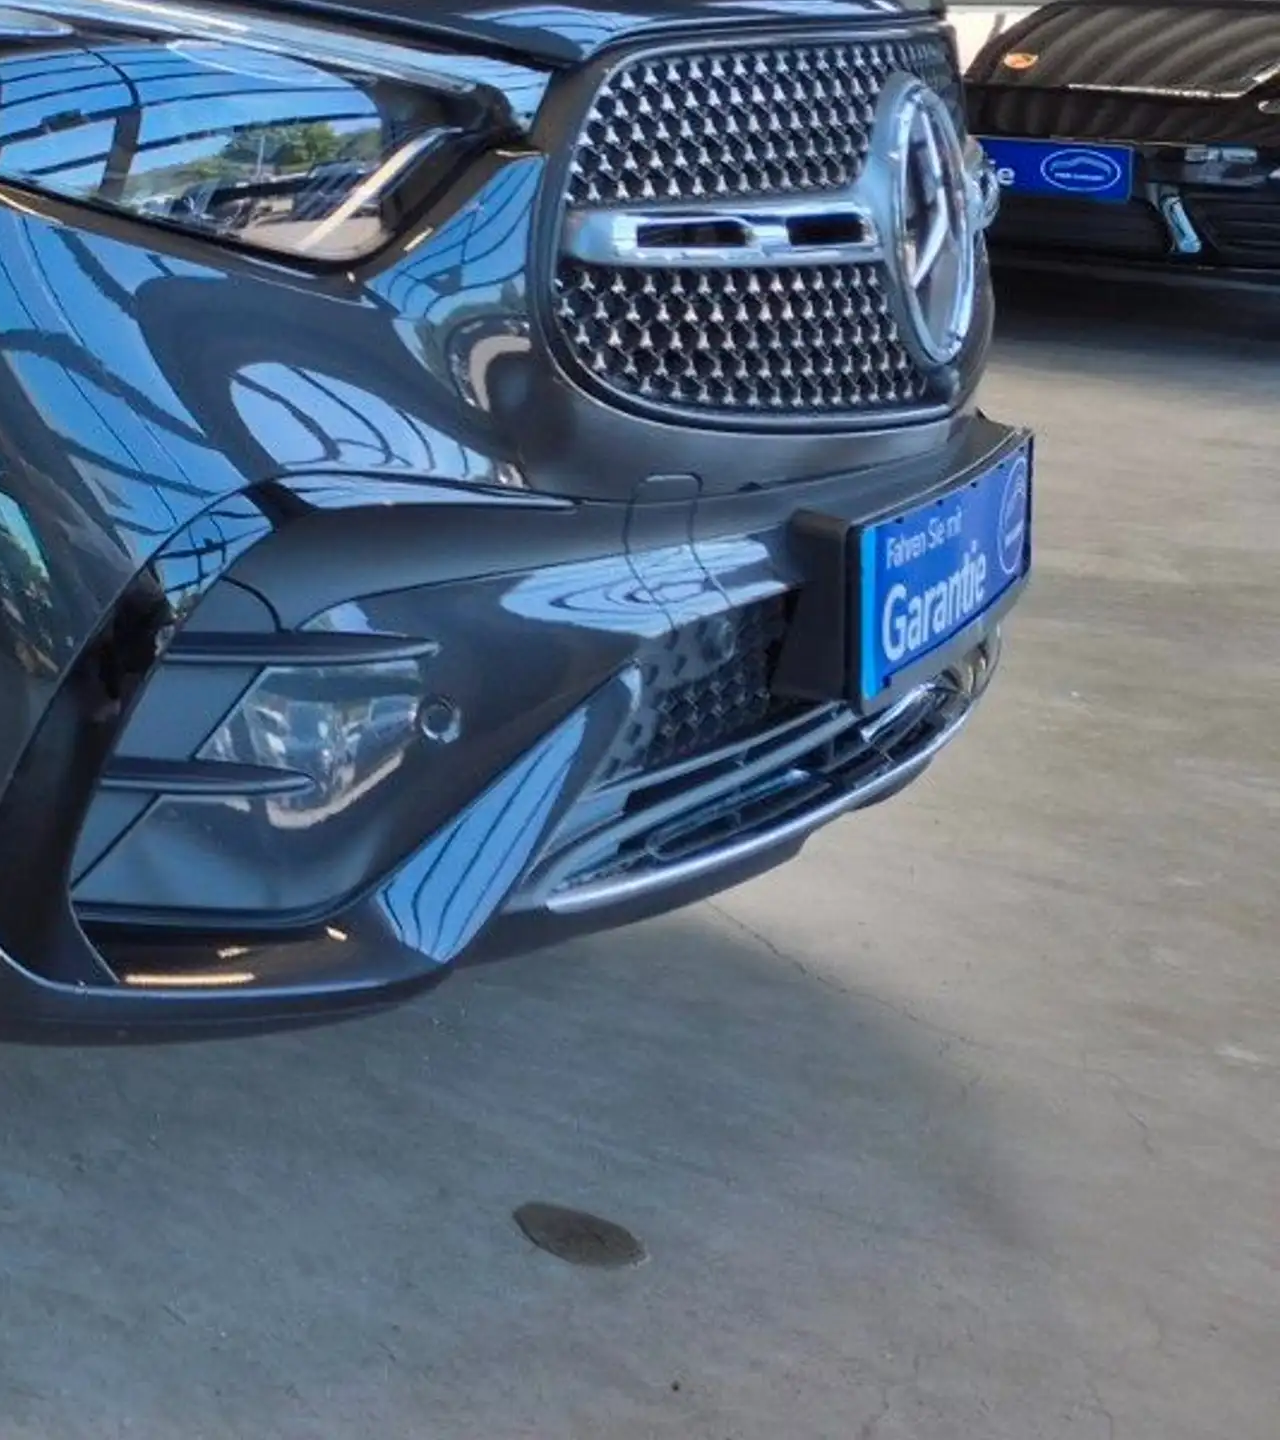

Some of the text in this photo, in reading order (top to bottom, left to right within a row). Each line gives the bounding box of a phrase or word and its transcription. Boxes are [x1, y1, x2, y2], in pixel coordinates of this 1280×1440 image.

[885, 531, 926, 571] Fahren
[927, 516, 945, 549] Sie
[881, 539, 987, 662] Garantie
